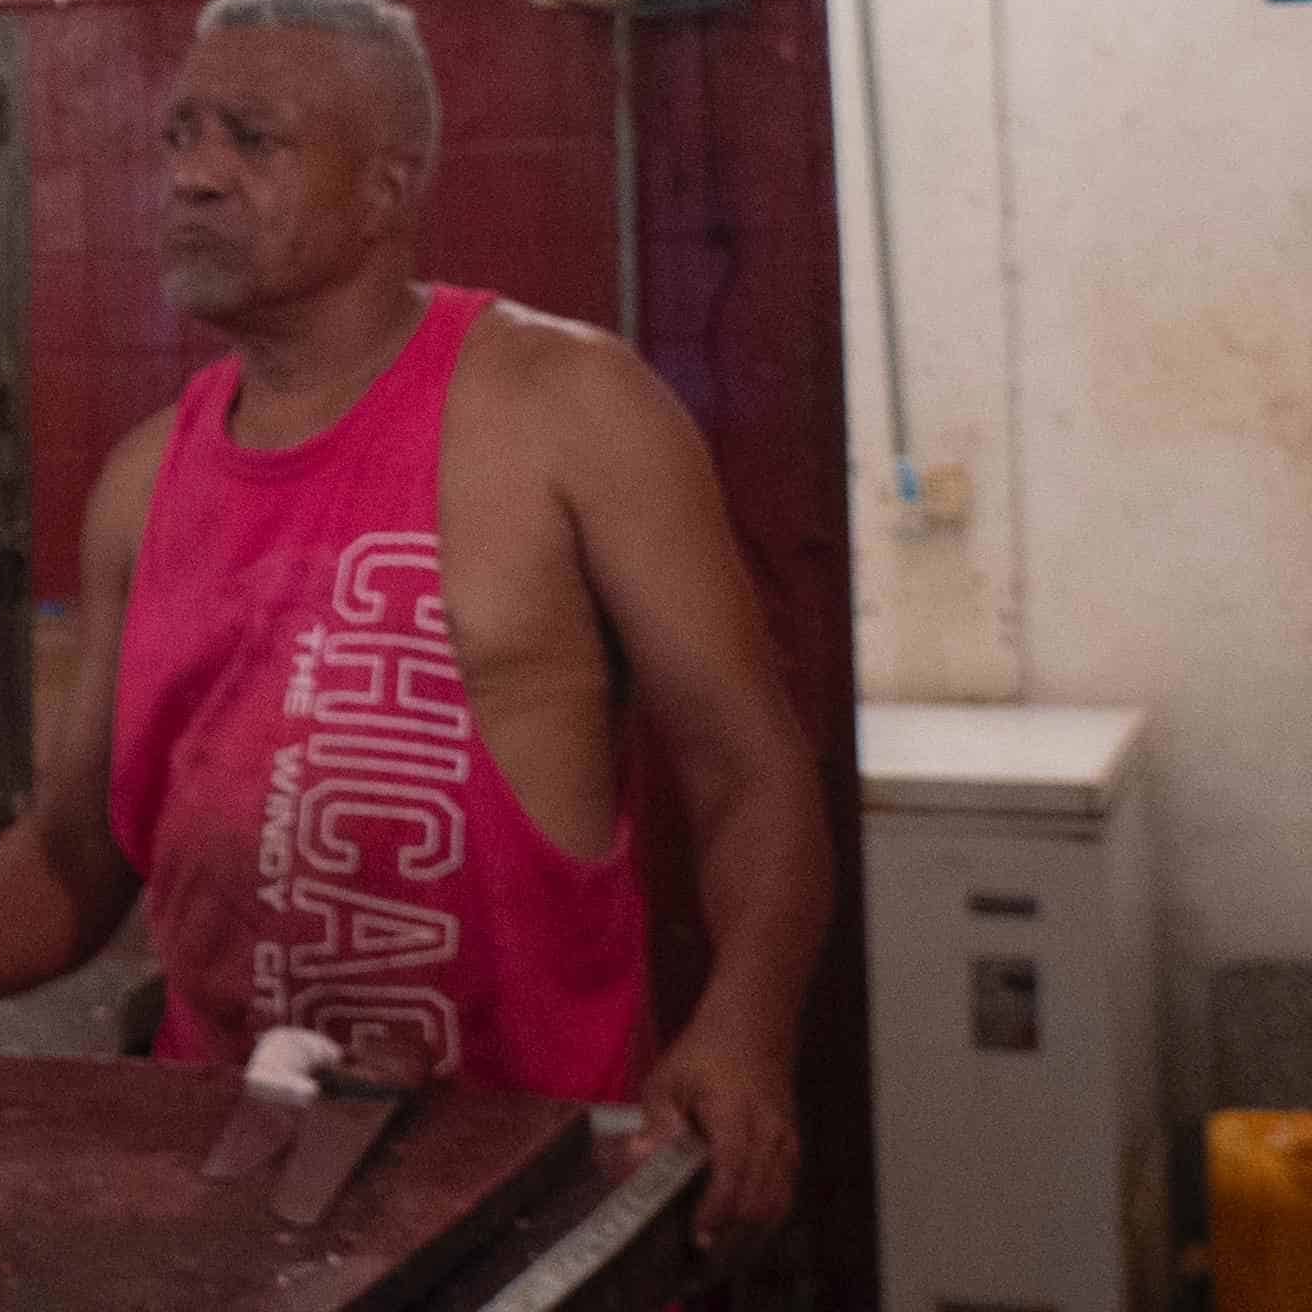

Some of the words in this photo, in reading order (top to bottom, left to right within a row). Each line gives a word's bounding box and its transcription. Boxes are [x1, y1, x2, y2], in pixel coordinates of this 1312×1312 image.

[283, 623, 328, 718] THE
[257, 741, 305, 914] WINDY
[253, 940, 290, 1020] CIT
